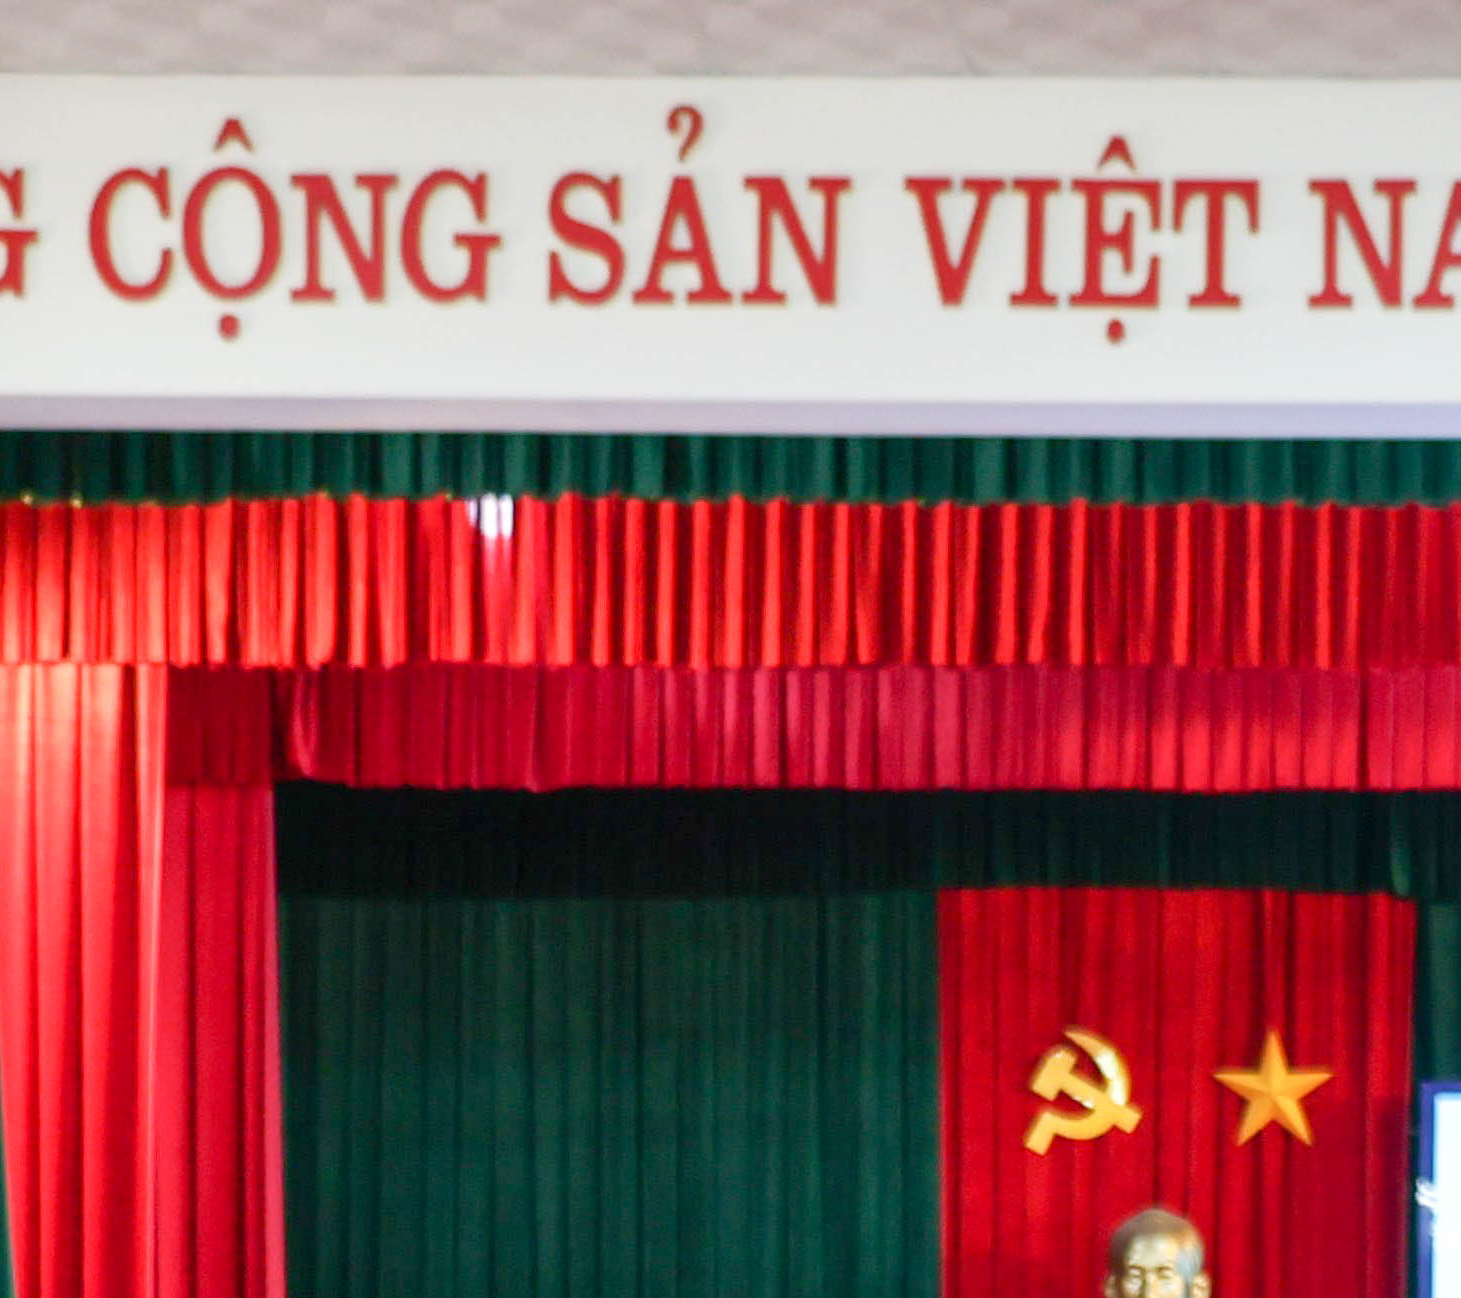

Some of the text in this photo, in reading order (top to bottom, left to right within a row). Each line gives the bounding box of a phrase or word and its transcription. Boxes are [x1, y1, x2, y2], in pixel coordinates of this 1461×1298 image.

[89, 119, 501, 338] CỘNG
[548, 107, 850, 306] SẢN
[906, 136, 1260, 343] VIỆT
